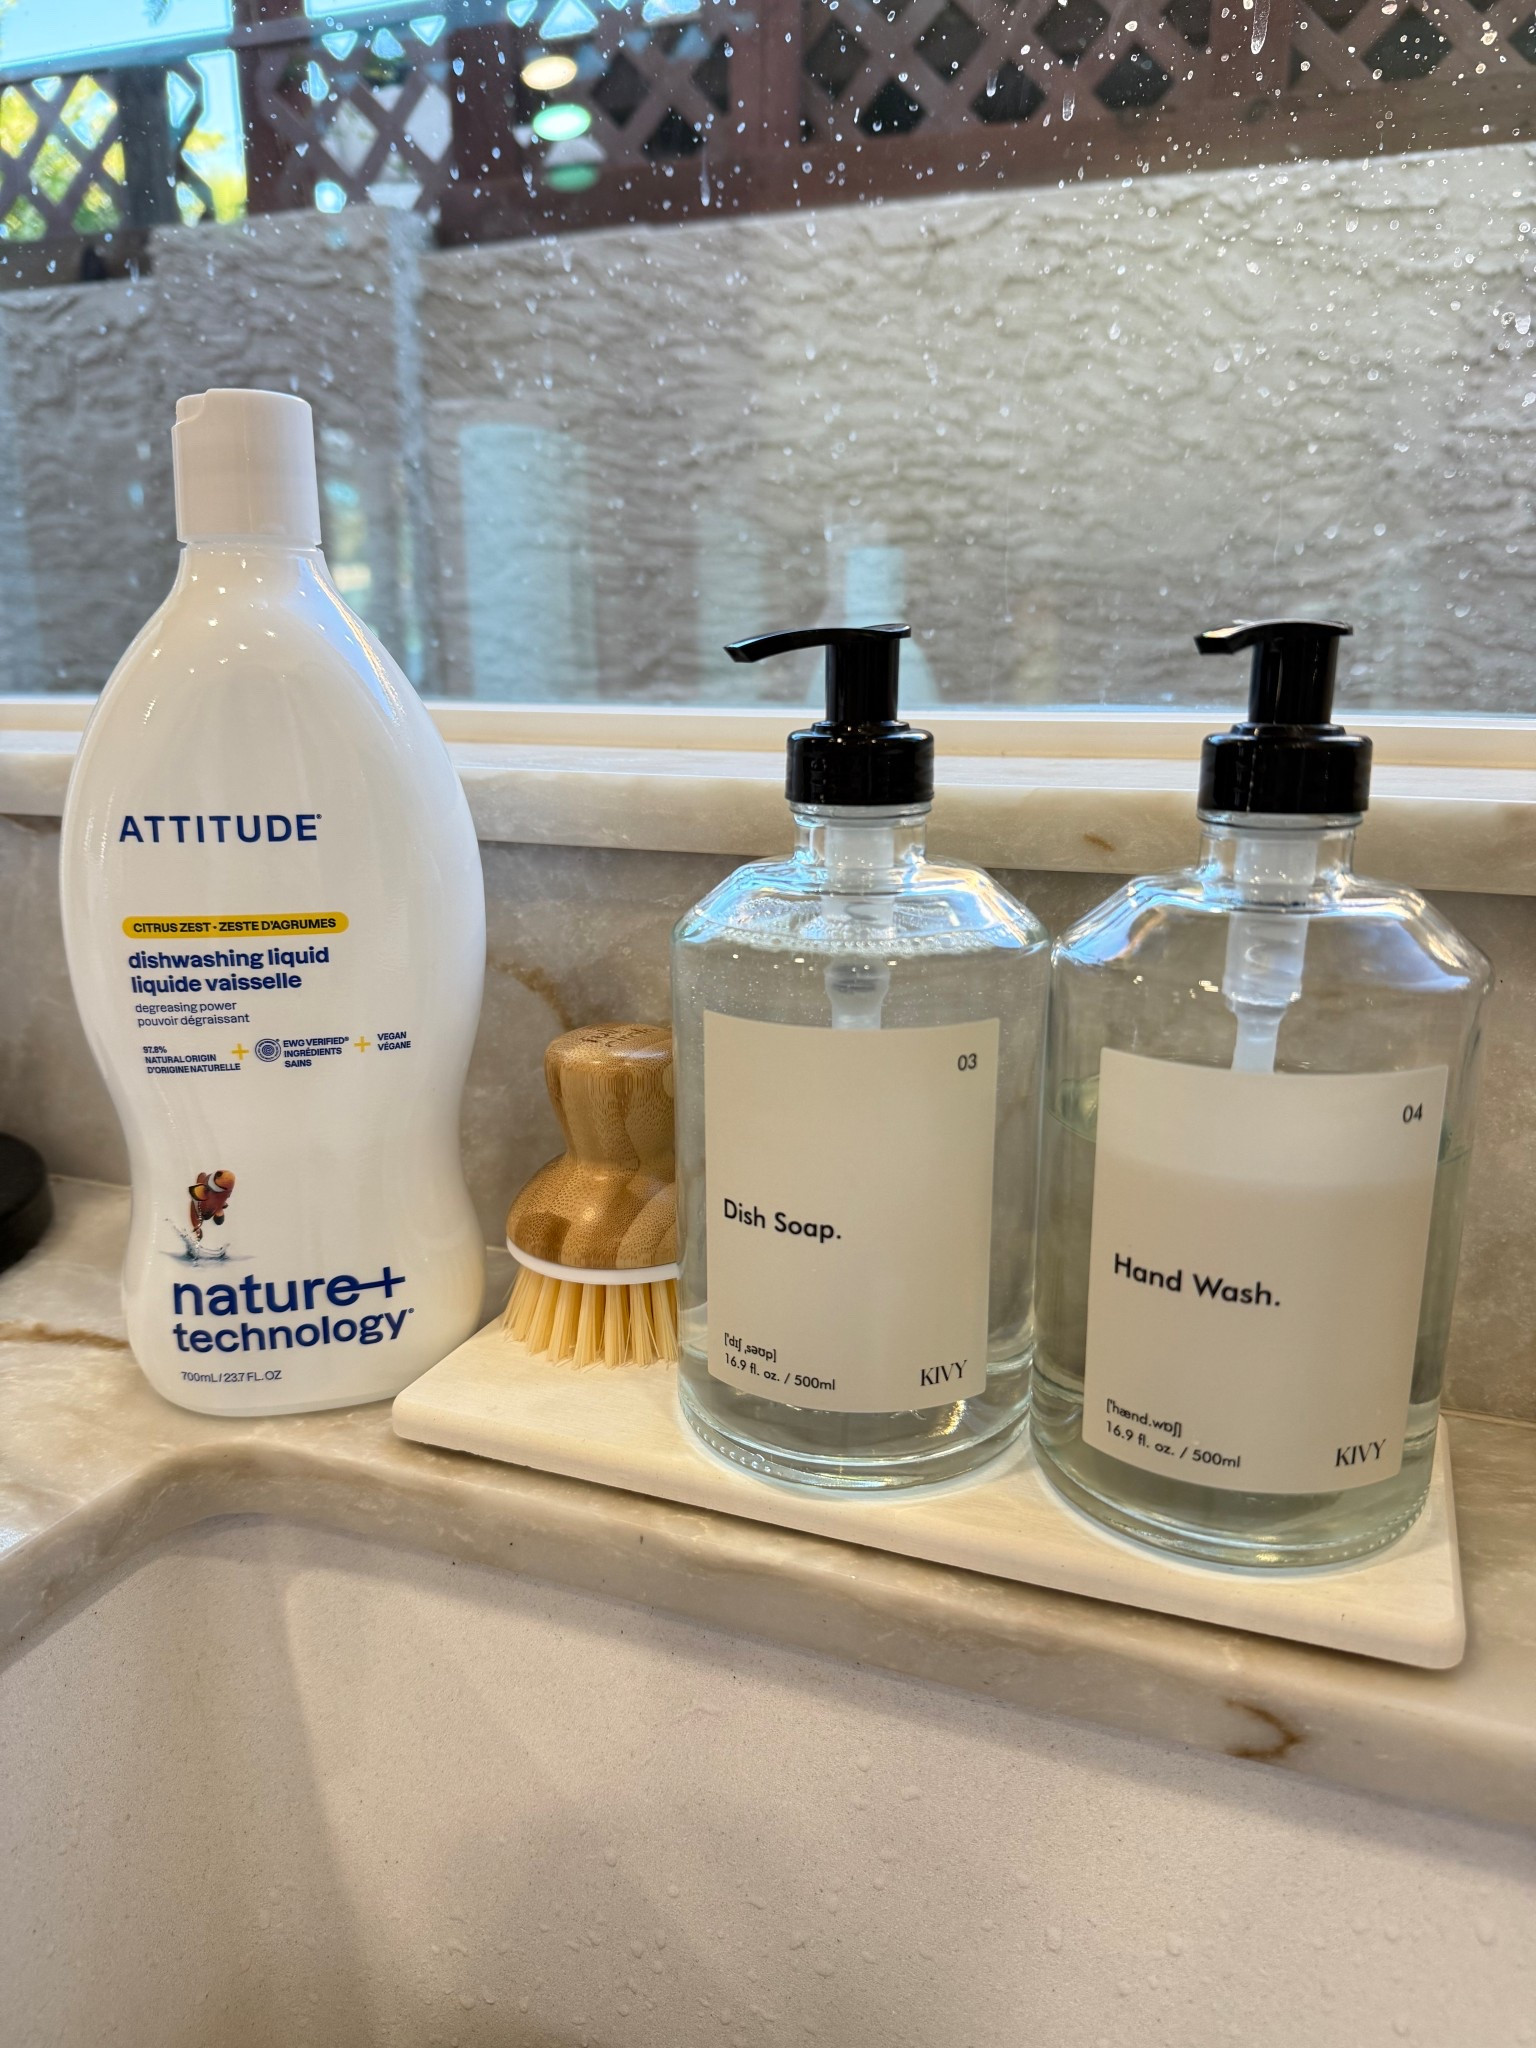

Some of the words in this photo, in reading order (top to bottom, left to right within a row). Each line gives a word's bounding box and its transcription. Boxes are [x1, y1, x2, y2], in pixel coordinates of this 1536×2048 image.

[133, 922, 178, 933] CITRUS
[180, 922, 211, 933] ZEST
[219, 921, 260, 932] ZESTE
[128, 949, 264, 970] dishwashing
[268, 946, 330, 968] liquid
[131, 974, 202, 996] liquide
[205, 972, 302, 992] vaisselle
[135, 1002, 198, 1015] degreasing
[199, 1002, 238, 1013] power
[137, 1015, 179, 1028] pouvoir
[181, 1013, 250, 1027] dégraissant
[283, 1040, 305, 1048] EWG
[377, 1031, 407, 1041] VEGAN
[284, 1047, 342, 1058] INGRÉDIENTS
[377, 1041, 411, 1051] VÉGANE
[145, 1056, 185, 1064] NATURAL
[185, 1054, 217, 1063] ORIGIN
[285, 1059, 312, 1068] SAINS
[957, 1053, 978, 1072] 03
[190, 1063, 241, 1073] NATURELLE
[1402, 1103, 1424, 1124] 04
[723, 1197, 767, 1230] Dish
[774, 1211, 842, 1244] Soap.
[1113, 1252, 1183, 1293] Hand
[1192, 1273, 1281, 1307] Wash.
[725, 1353, 747, 1370] 16.9
[750, 1362, 760, 1375] fl.
[763, 1370, 780, 1382] oz.
[794, 1374, 835, 1391] 500ml
[919, 1358, 968, 1387] KIVY
[1106, 1420, 1134, 1441] 16.9
[1138, 1433, 1149, 1448] fl.
[1154, 1442, 1175, 1456] oz.
[1192, 1448, 1241, 1468] 500ml
[1334, 1438, 1387, 1469] KIVY
